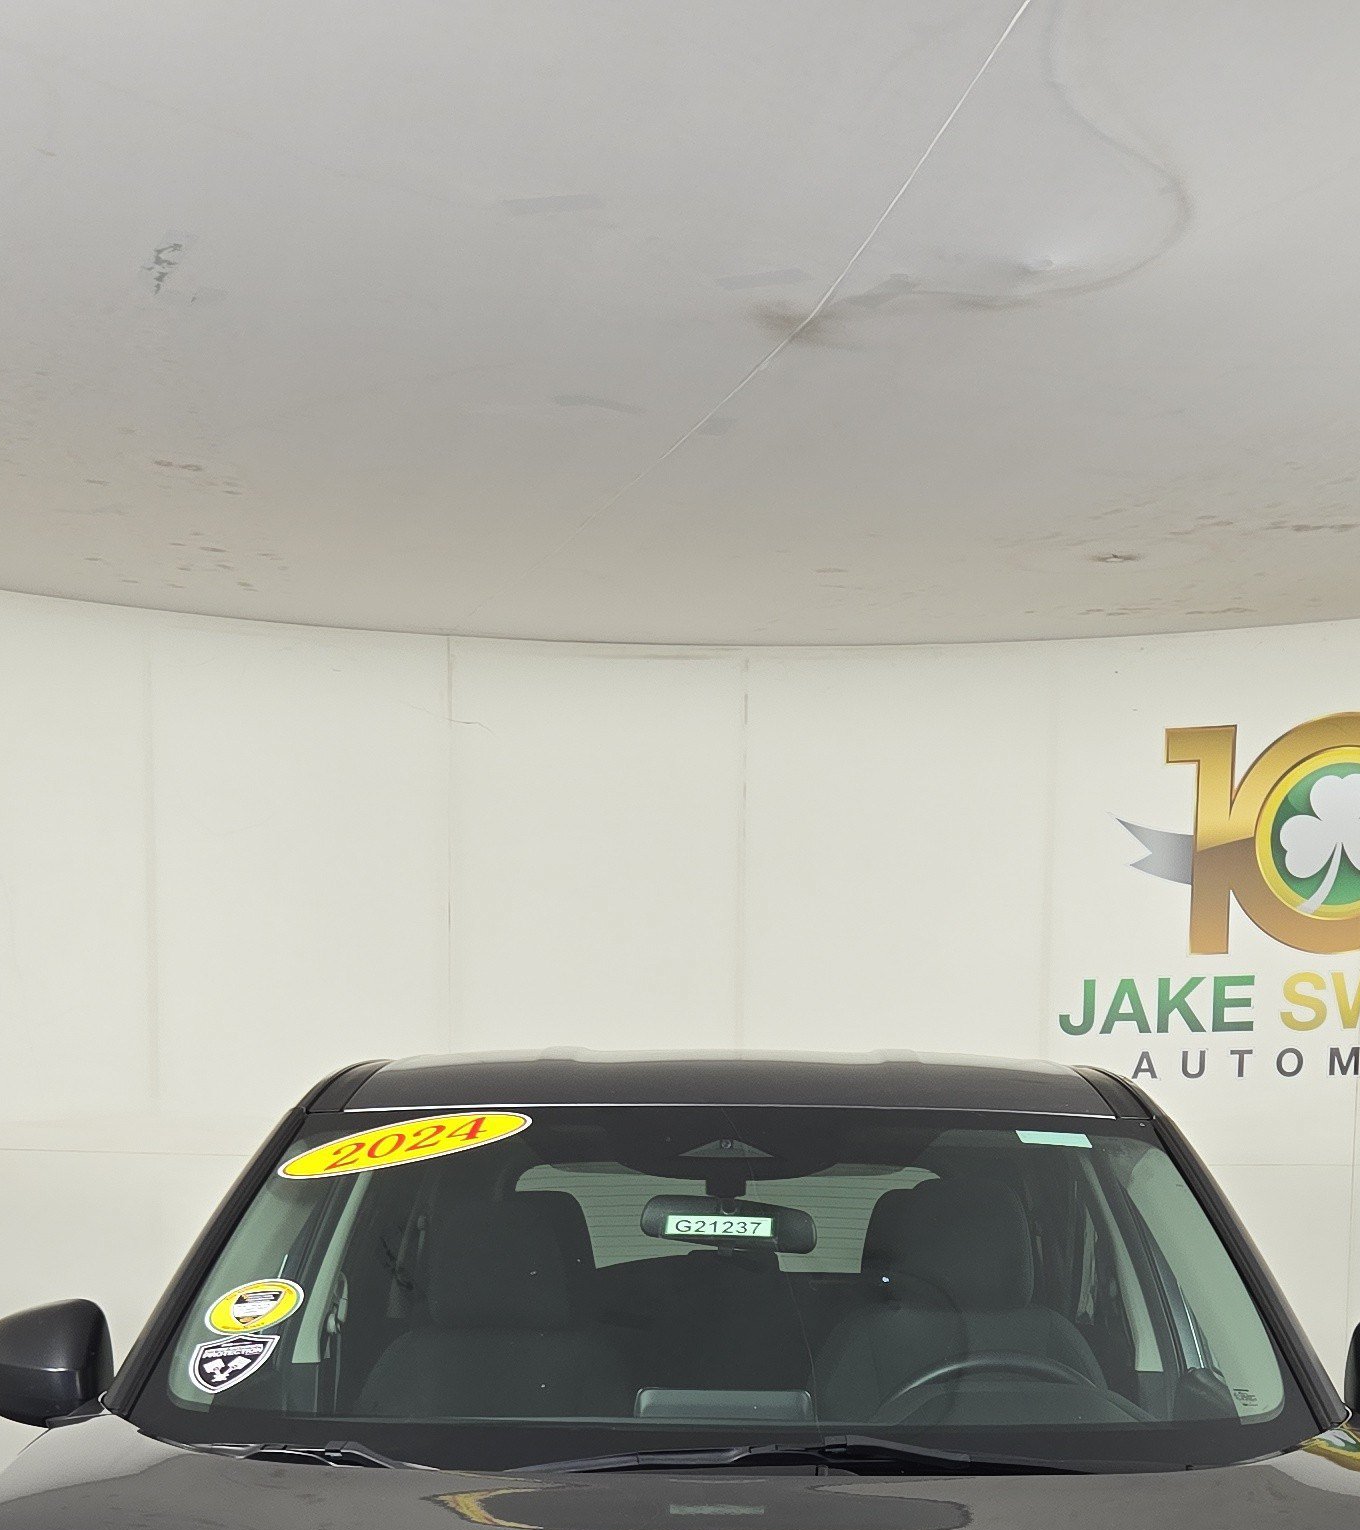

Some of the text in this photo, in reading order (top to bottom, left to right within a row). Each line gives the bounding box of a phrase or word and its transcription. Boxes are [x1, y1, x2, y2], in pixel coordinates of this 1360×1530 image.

[1058, 974, 1256, 1036] JAKE
[324, 1116, 487, 1171] 2024
[675, 1219, 762, 1235] G21237
